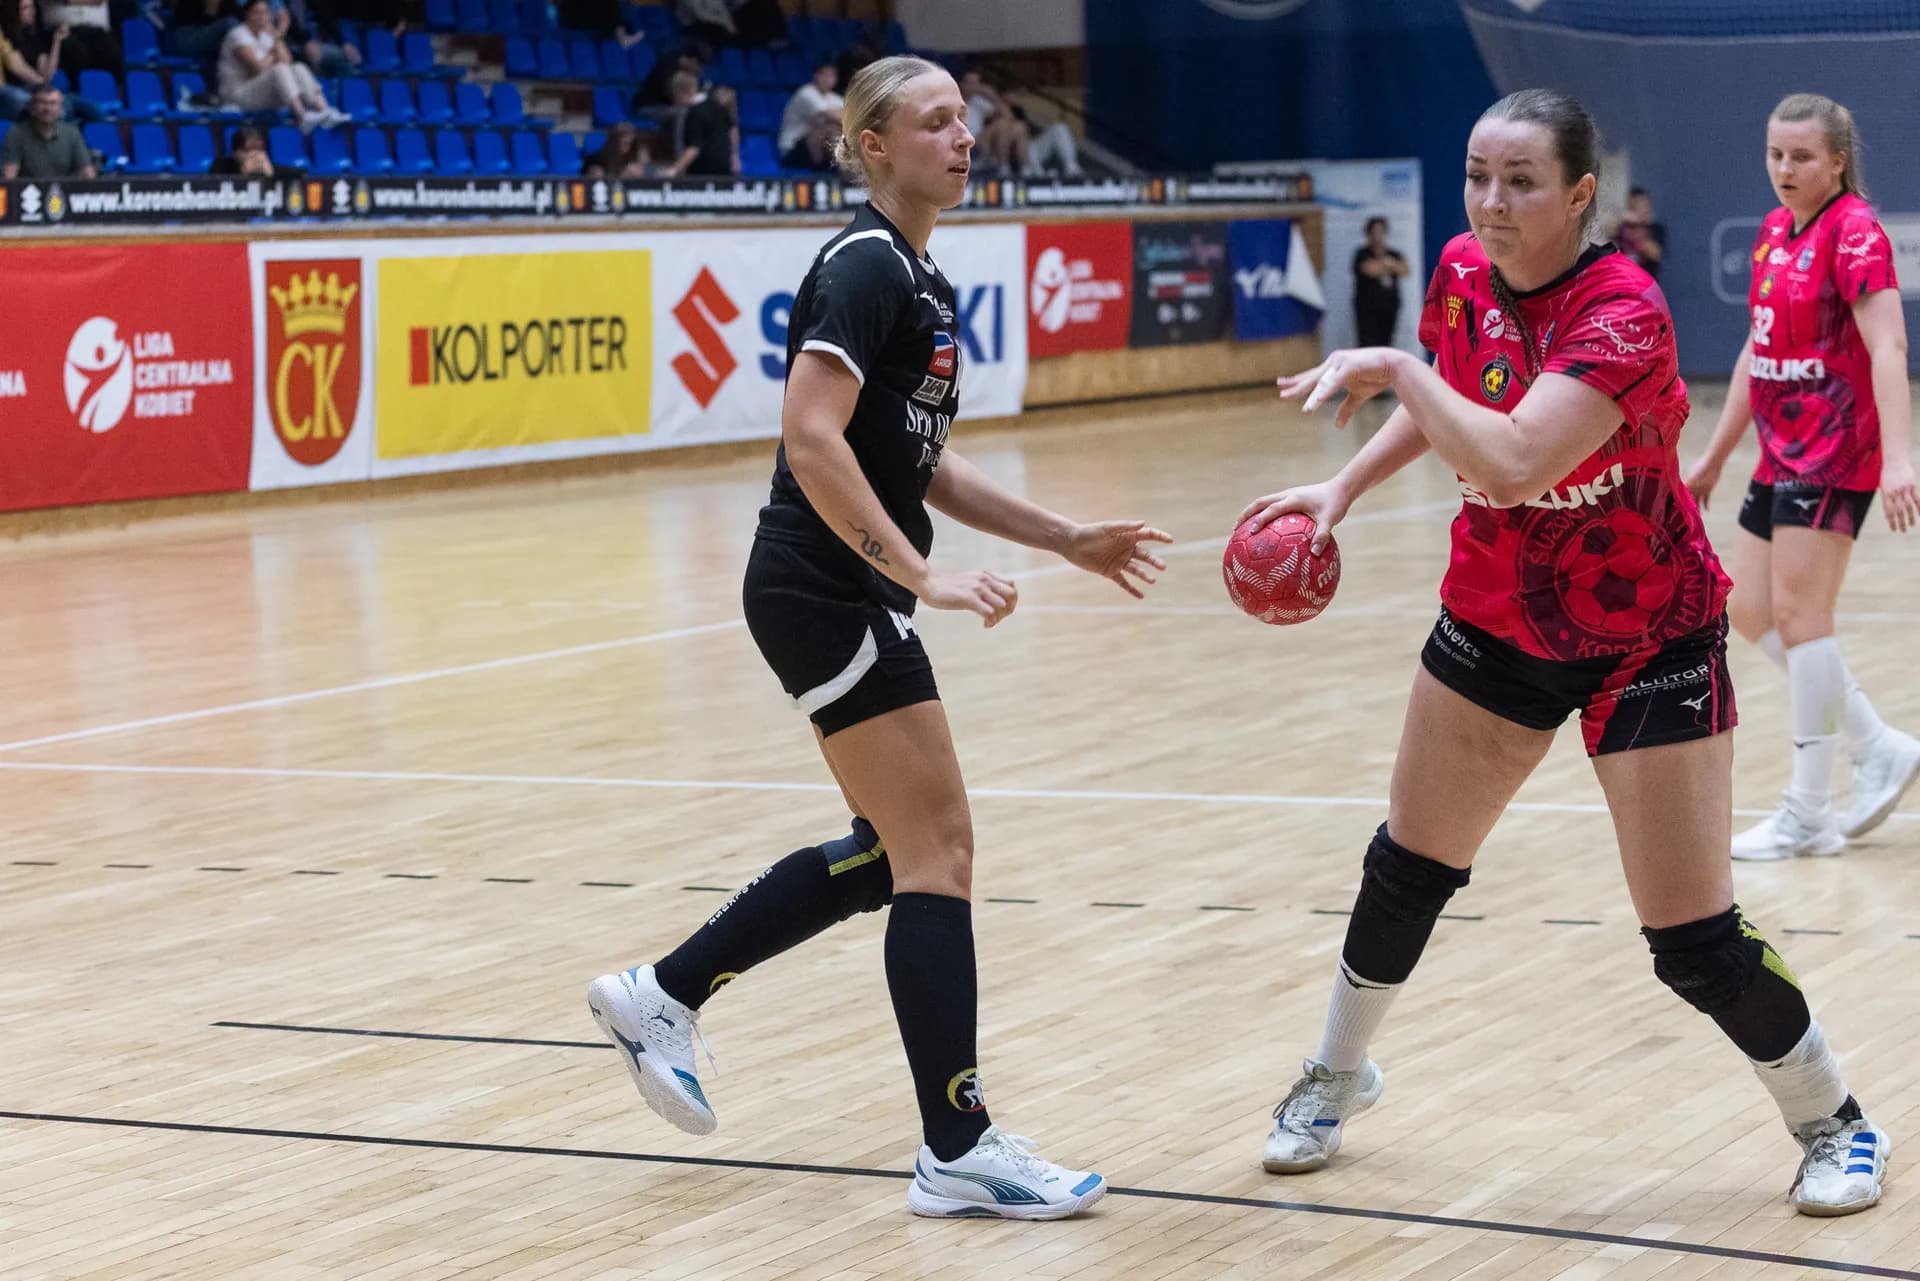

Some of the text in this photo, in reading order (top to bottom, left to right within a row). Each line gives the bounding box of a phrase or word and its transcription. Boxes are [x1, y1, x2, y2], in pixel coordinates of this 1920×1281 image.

[133, 331, 175, 359] LIGA
[431, 316, 628, 385] KOLPORTER
[133, 359, 233, 389] CENTRALNA
[133, 390, 196, 418] KOBIET
[276, 341, 345, 441] CK
